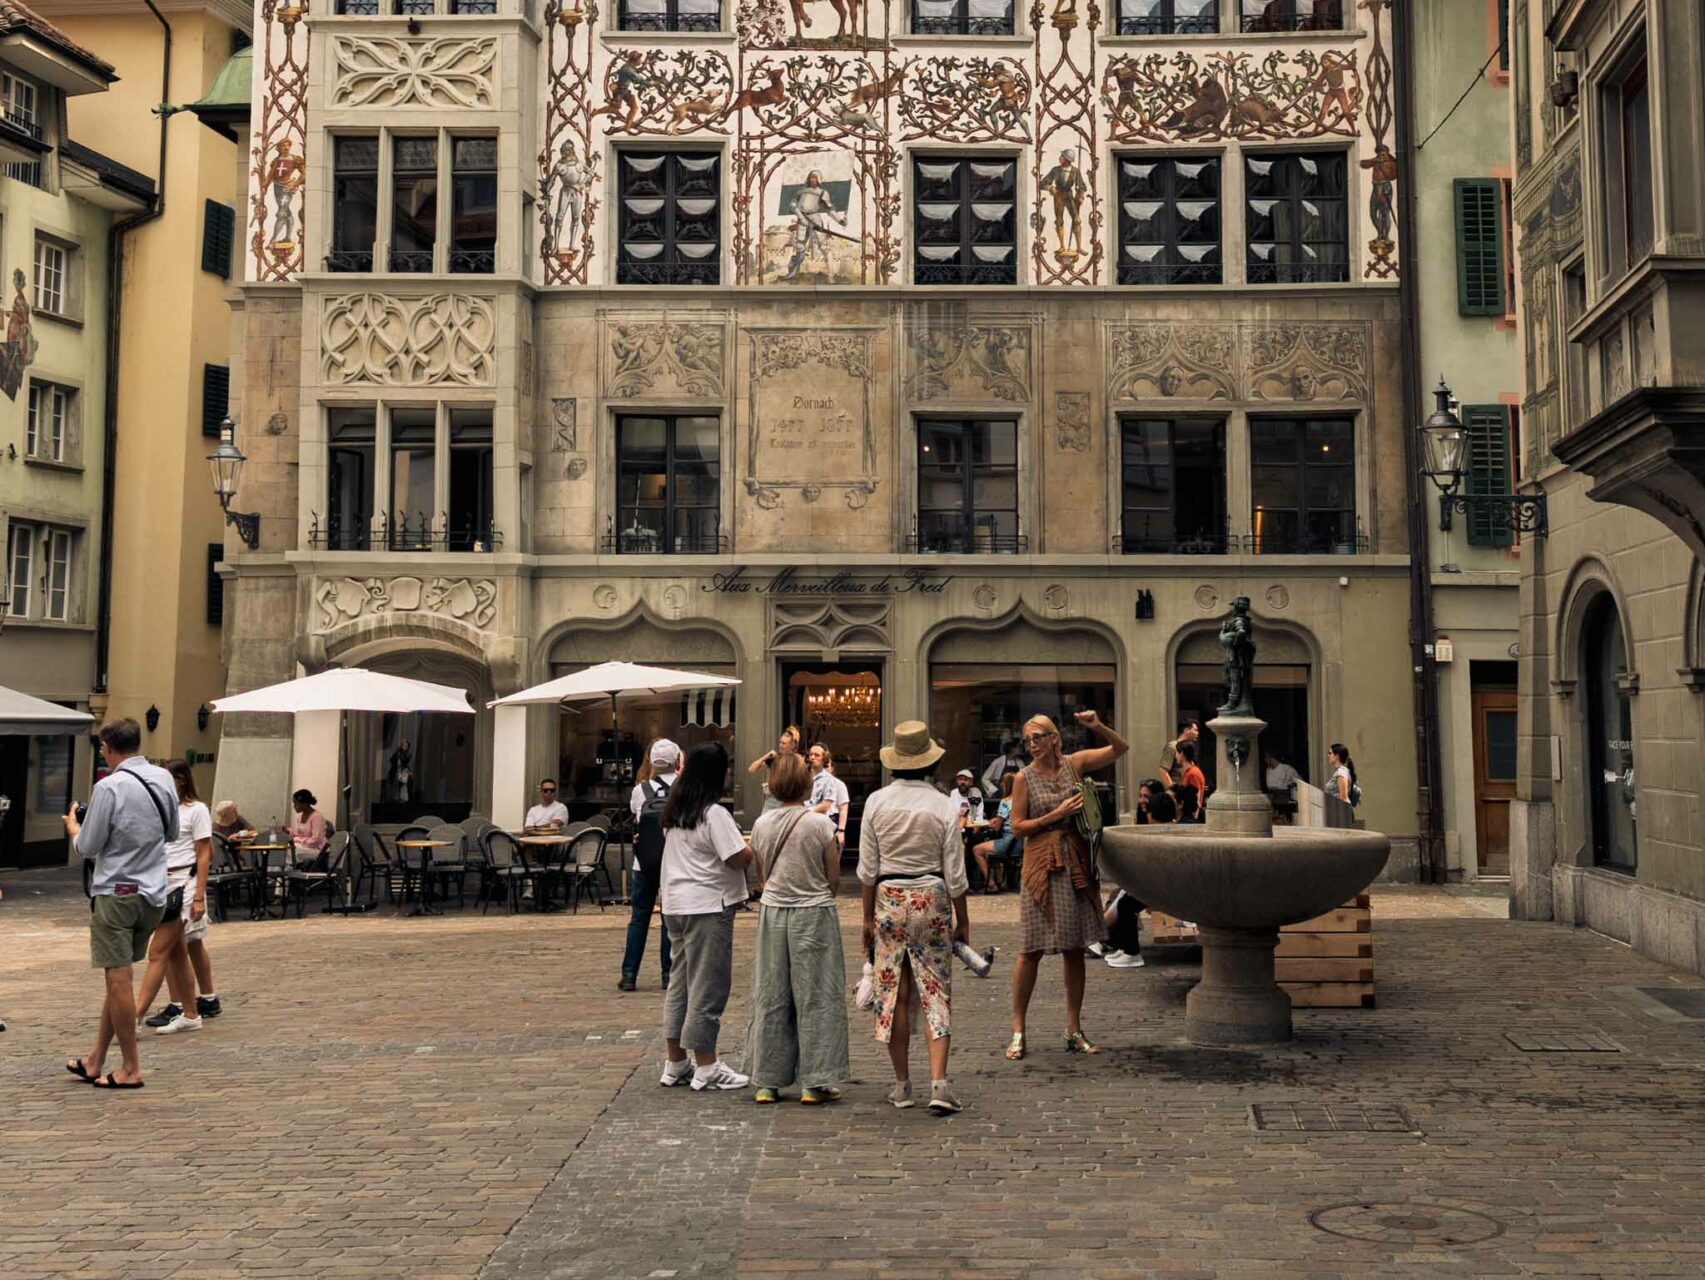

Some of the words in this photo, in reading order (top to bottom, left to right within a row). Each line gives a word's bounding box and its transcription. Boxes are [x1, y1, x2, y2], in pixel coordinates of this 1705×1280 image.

[792, 395, 835, 410] Dornach
[701, 566, 751, 593] Aux
[755, 566, 867, 593] Merveilleux
[870, 574, 893, 593] de
[894, 567, 955, 593] Fred
